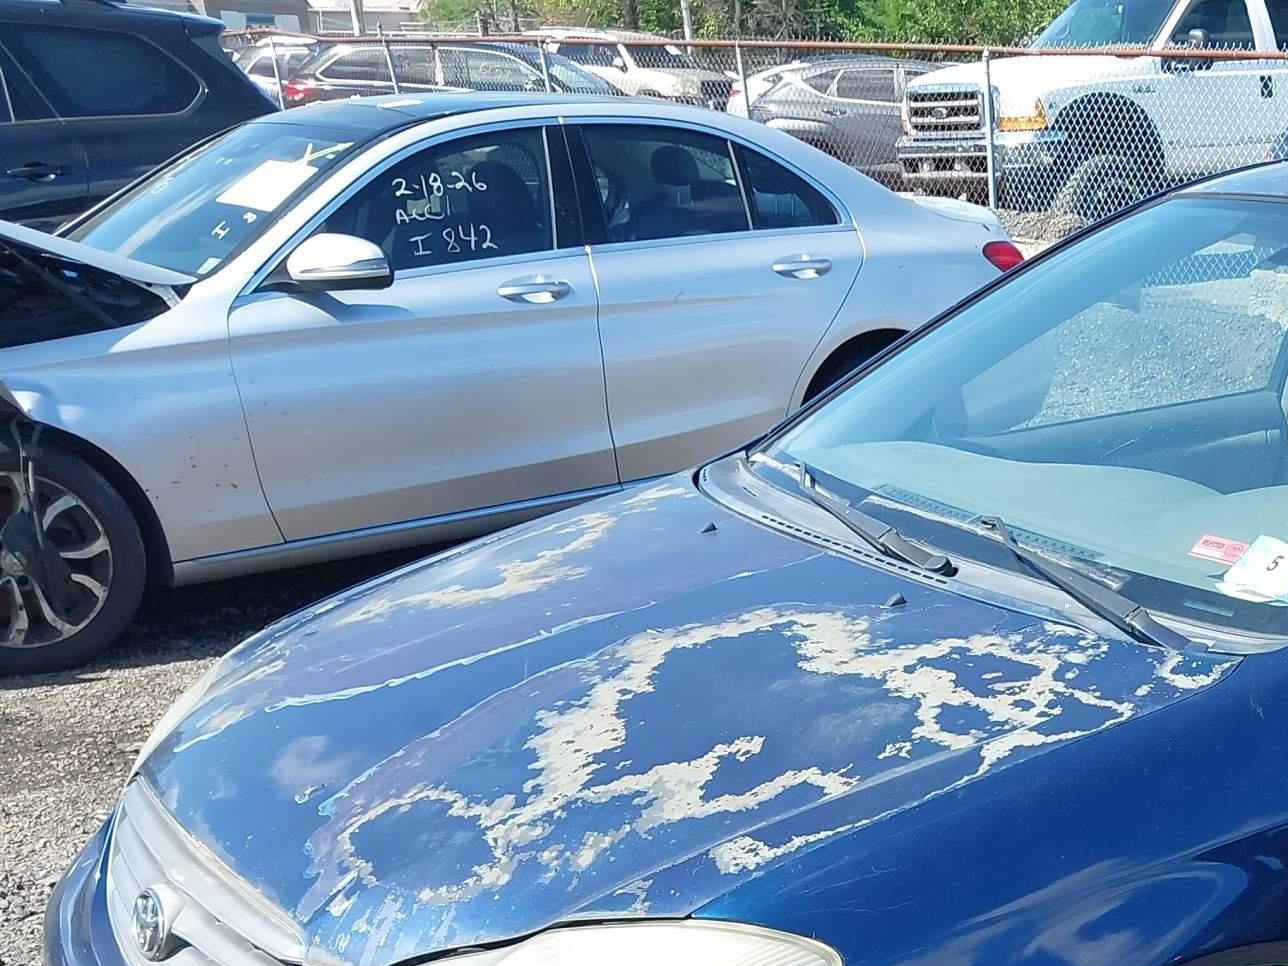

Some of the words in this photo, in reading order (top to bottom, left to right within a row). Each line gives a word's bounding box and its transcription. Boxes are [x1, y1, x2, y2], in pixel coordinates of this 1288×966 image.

[392, 171, 487, 205] 2-18-26
[442, 222, 498, 253] 842
[1265, 555, 1285, 572] 5
